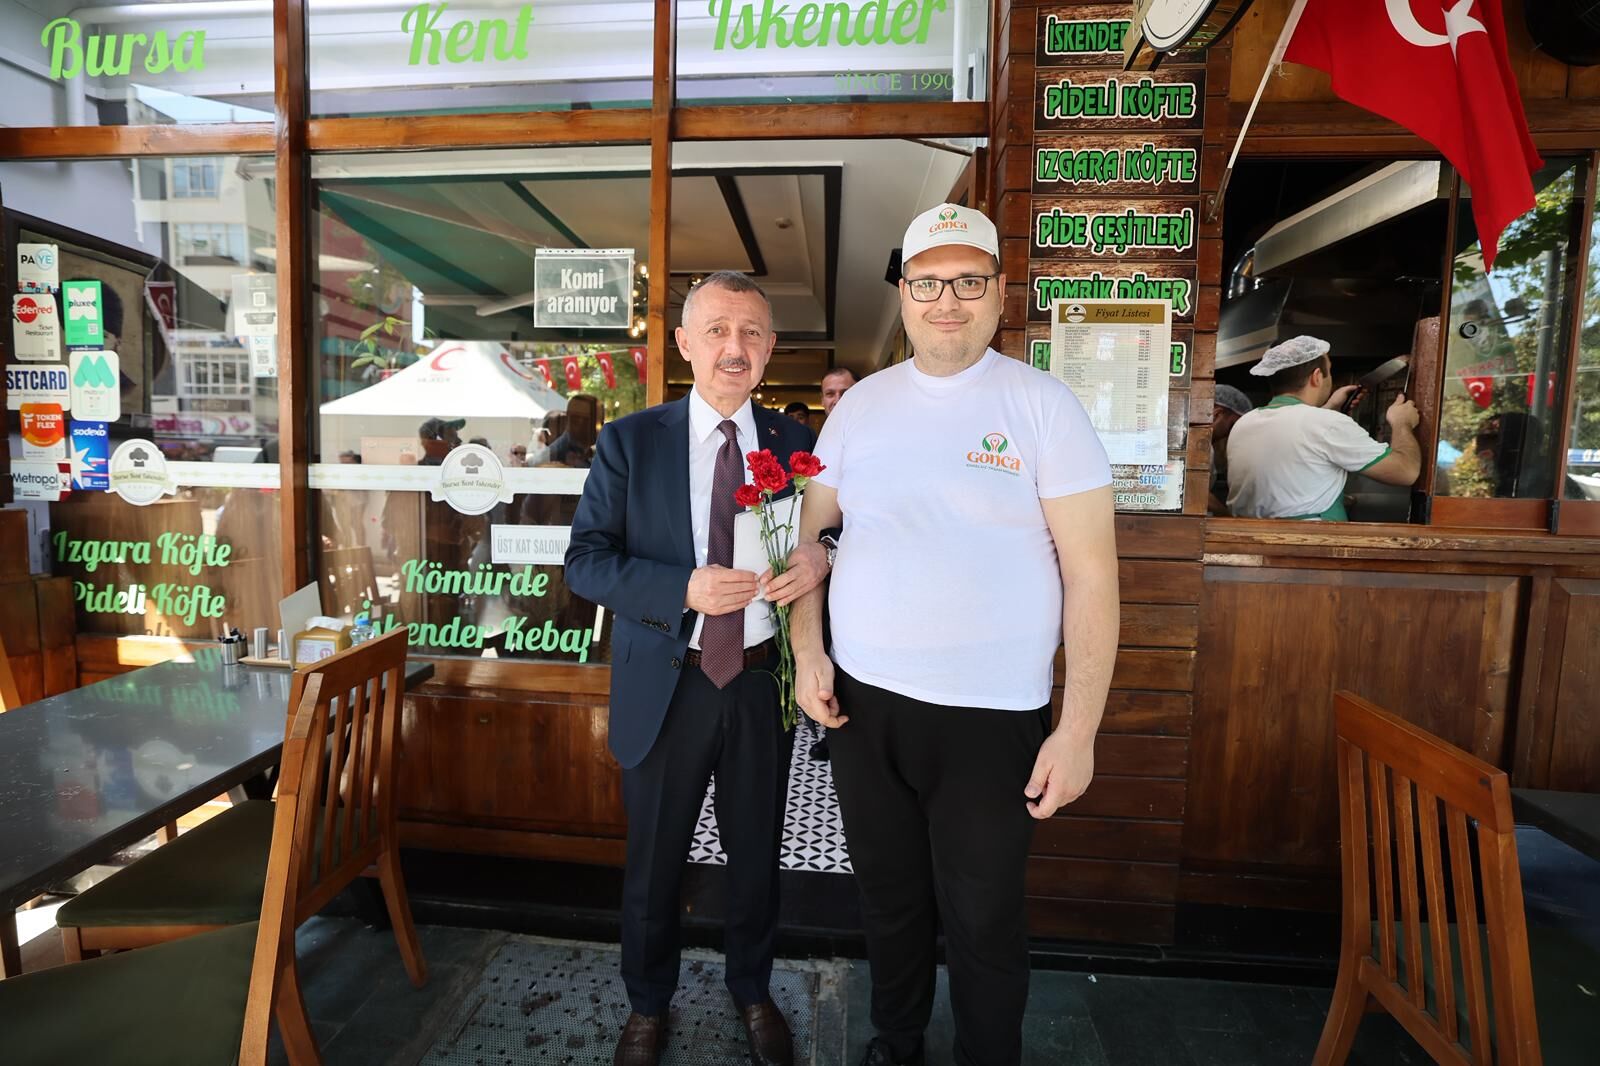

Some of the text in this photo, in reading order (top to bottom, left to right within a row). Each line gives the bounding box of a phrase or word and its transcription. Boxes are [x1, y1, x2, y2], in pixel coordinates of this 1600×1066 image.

[41, 17, 206, 80] Bursa
[401, 2, 534, 65] Kent
[911, 73, 956, 91] 1990
[1045, 79, 1196, 121] PİDELİ KÖFTE
[1037, 144, 1197, 185] IZGARA KÖFTE
[1037, 208, 1193, 254] PİDE ÇEŞİTLERİ
[561, 268, 604, 289] Komi
[1117, 273, 1190, 316] DÖNER
[16, 304, 52, 314] Edenred
[68, 301, 96, 309] pluxee
[547, 295, 618, 316] aranıyor
[1095, 308, 1151, 318] Fiyat Listesi
[7, 370, 67, 390] SETCARD
[35, 413, 62, 421] TOKEN
[73, 425, 106, 436] sodexo
[1140, 464, 1164, 473] VISA
[13, 472, 58, 486] Metropol
[53, 530, 232, 576] Izgara Köfte
[497, 536, 513, 553] ÜST
[516, 538, 530, 553] KAT
[401, 558, 549, 597] Kömürde
[152, 582, 226, 626] Köfte
